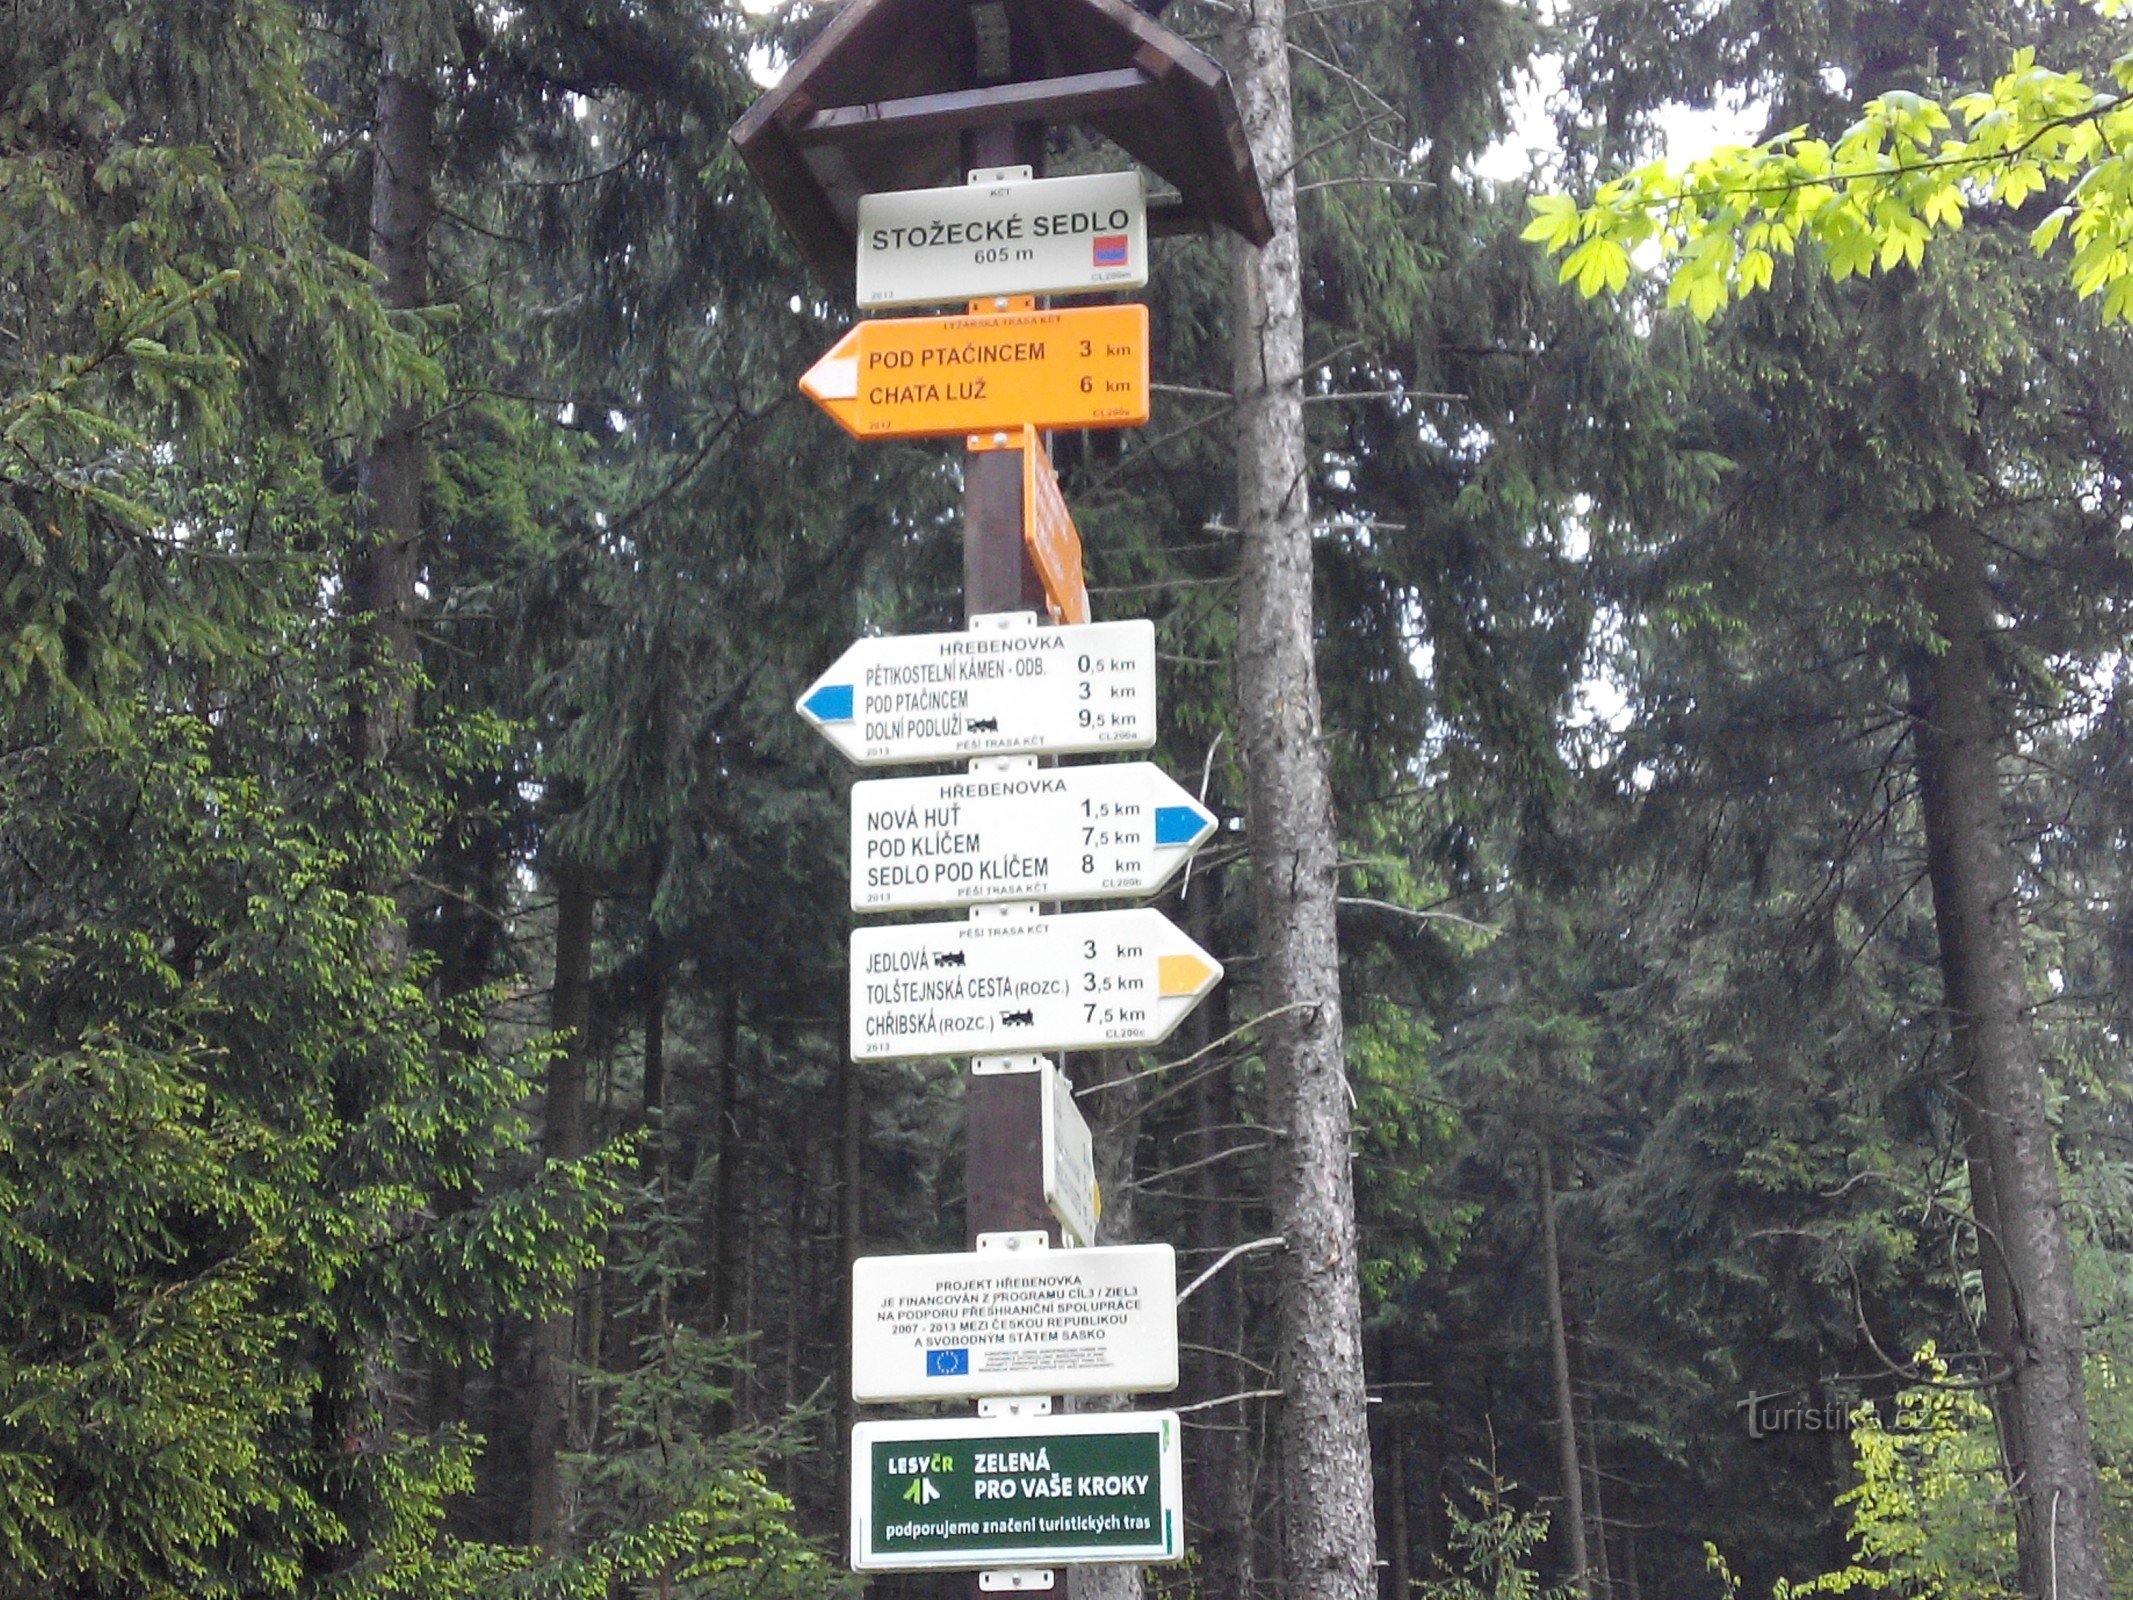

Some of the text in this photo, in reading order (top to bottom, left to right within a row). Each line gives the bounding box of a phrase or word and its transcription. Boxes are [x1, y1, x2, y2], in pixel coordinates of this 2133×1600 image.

[872, 209, 1129, 250] STOŽECKÉ SEDLO
[975, 249, 1034, 264] 605 m
[869, 338, 1131, 370] POD PTAČINCEM 3 km
[869, 376, 1131, 405] CHATA LUŽ 6 km
[940, 636, 1065, 656] HŘEBENOVKA
[866, 662, 956, 687] PĚTIKOSTELNÍ
[959, 658, 1005, 680] KÁMEN
[1016, 658, 1047, 677] ODB.
[1077, 654, 1105, 675] 0,5
[1110, 657, 1136, 673] km
[866, 681, 1136, 714] POD PTAČINCEM 3 km
[866, 708, 1136, 741] DOLNÍ PODLUŽÍ 9,5 km
[985, 737, 1020, 749] TRASA
[940, 779, 1067, 799] HŘEBENOVKA
[868, 798, 1140, 832] NOVÁ HUŤ 1,5 km
[868, 826, 1140, 860] POD KLÍČEM 7,5 km
[868, 854, 1141, 887] SEDLO POD KLÍČEM 8 km
[986, 883, 1023, 896] TRASA
[1026, 882, 1048, 894] KČT
[987, 925, 1024, 937] TRASA
[1027, 923, 1050, 935] KČT
[866, 940, 1143, 974] JEDLOVÁ 3 km
[866, 972, 1144, 1005] TOLŠTEJNSKÁ CESTA (ROZC.) 3,5 km
[866, 1003, 1145, 1037] CHŘIBSKÁ (ROZC.) 7,5 km
[936, 1275, 1082, 1293] PROJEKT HŘEBENOVKA
[877, 1299, 1141, 1321] NA PODPORU PŘESHRANIČNÍ SPOLUPRÁCE
[881, 1297, 895, 1308] JE
[899, 1293, 979, 1307] FINANCOVÁN
[982, 1293, 990, 1304] Z
[993, 1290, 1064, 1304] PROGRAMU
[892, 1323, 918, 1335] 2007
[929, 1322, 956, 1333] 2013
[959, 1320, 988, 1332] MEZI
[991, 1317, 1043, 1331] ČESKOU
[1047, 1314, 1128, 1328] REPUBLIKOU
[914, 1328, 1106, 1348] A SVOBODNÝM STÁTEM SASKO
[974, 1447, 1050, 1473] ZELENÁ
[974, 1473, 1149, 1499] PRO VAŠE KROKY
[886, 1515, 1150, 1541] podporujeme značení turistických tras
